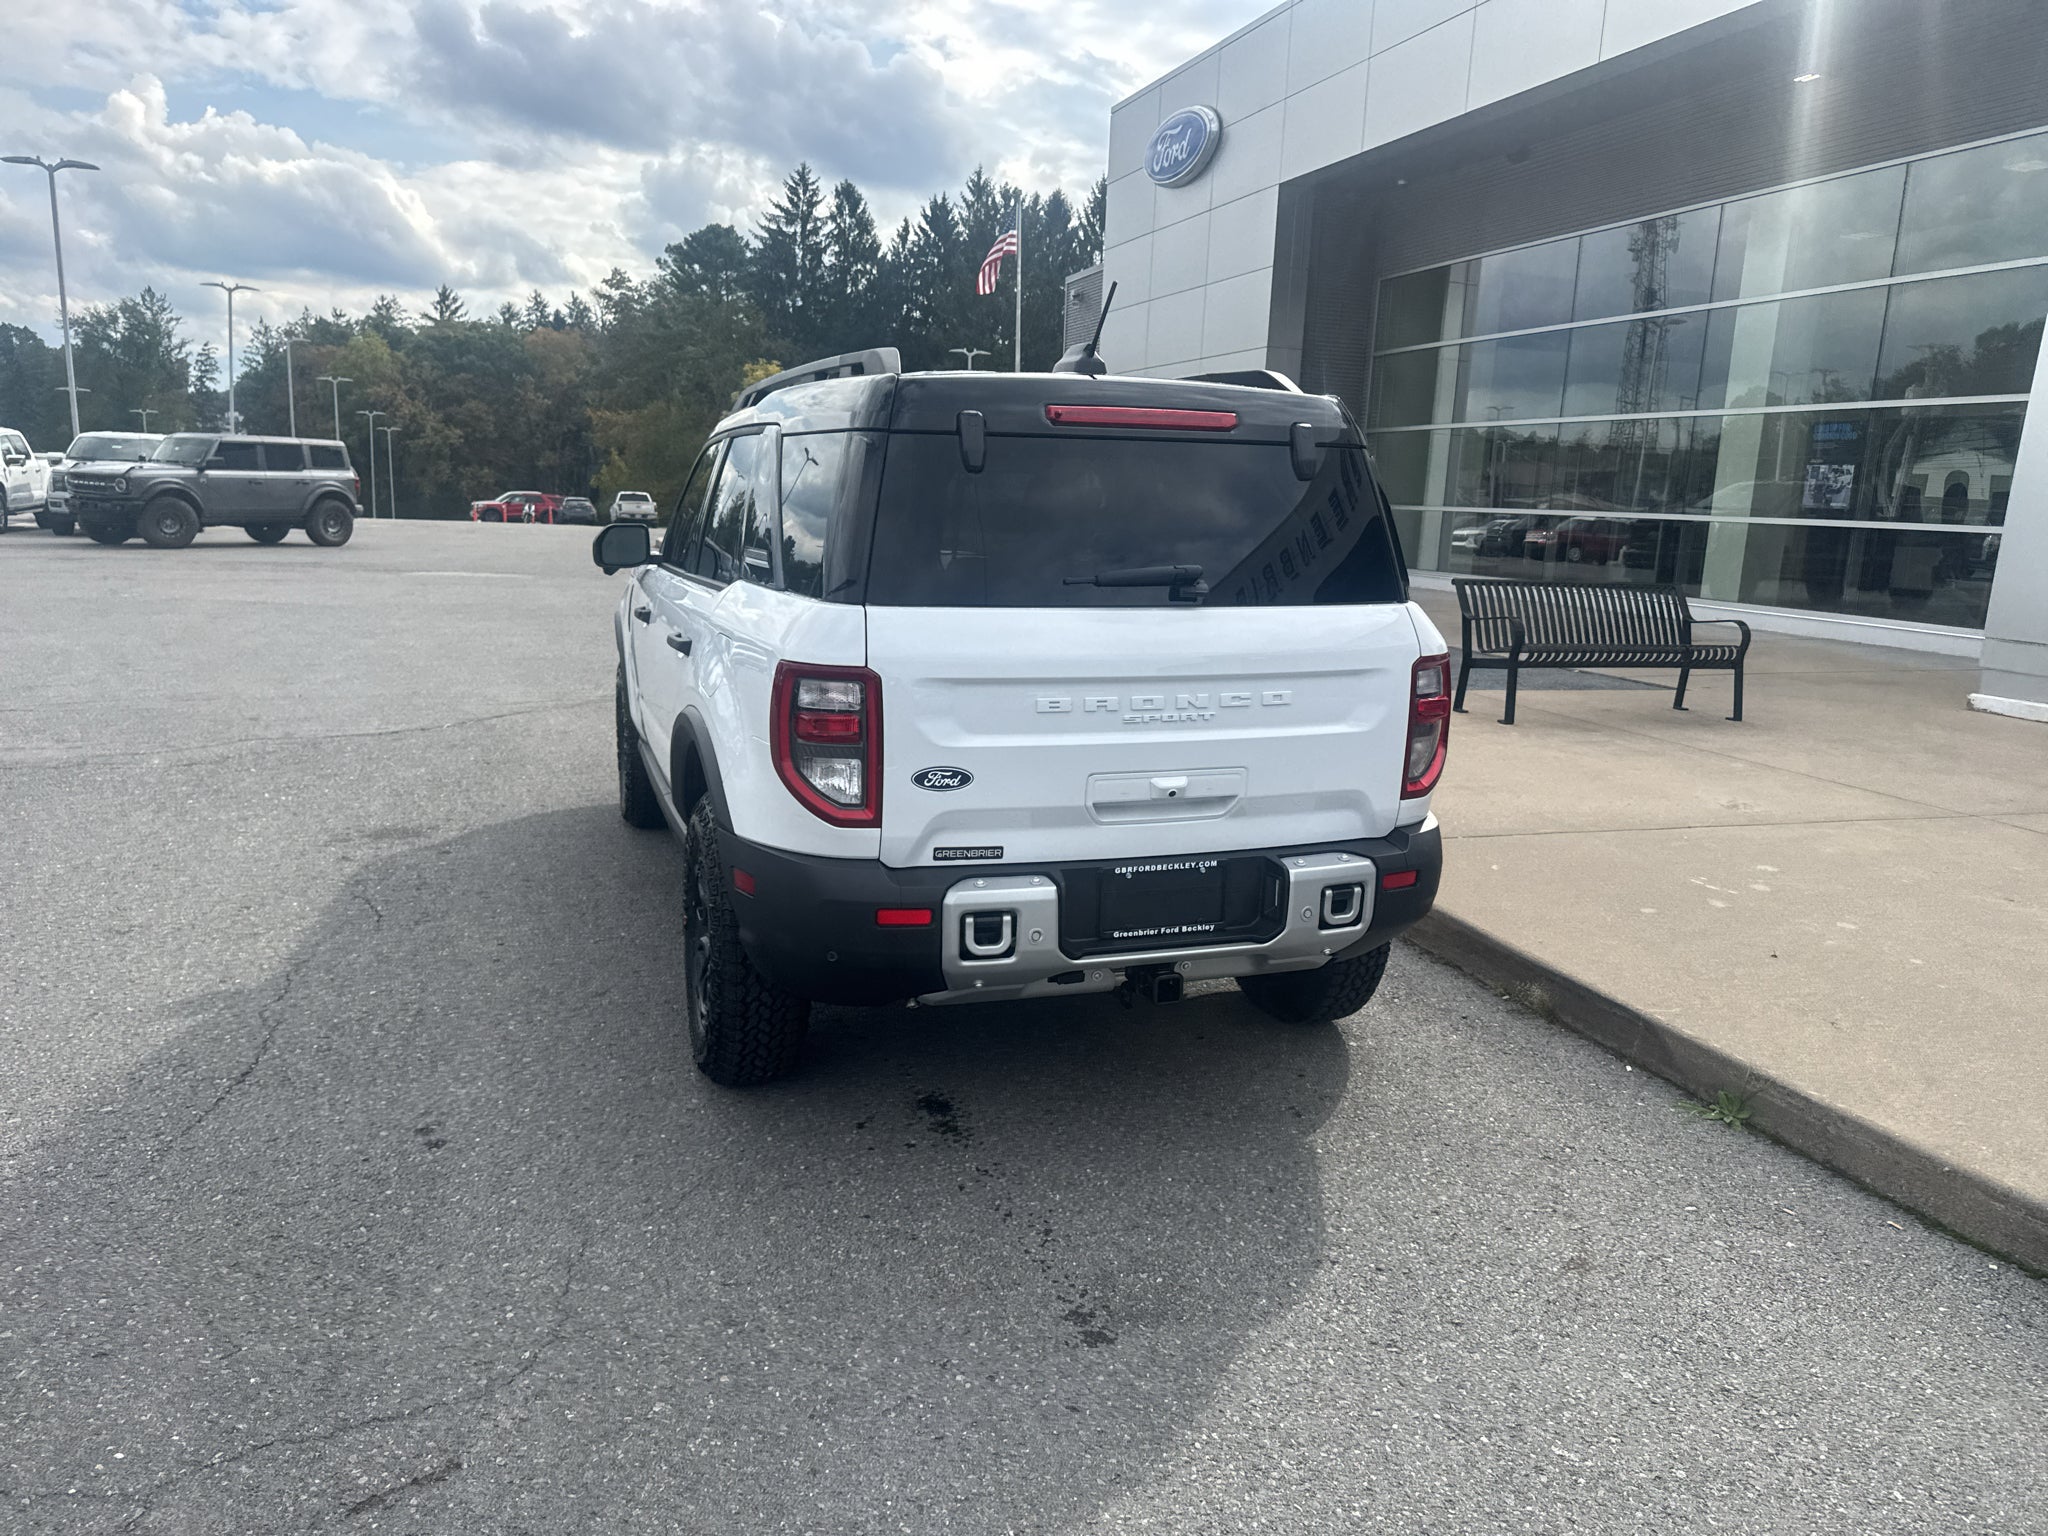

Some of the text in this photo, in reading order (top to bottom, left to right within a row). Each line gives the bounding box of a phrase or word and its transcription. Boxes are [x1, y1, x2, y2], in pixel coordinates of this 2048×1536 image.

[1153, 124, 1193, 172] Ford
[1036, 690, 1293, 713] BRONCO
[1122, 711, 1216, 724] SPORT
[923, 770, 962, 787] Ford
[934, 848, 1003, 859] GREENBRIER
[1114, 860, 1218, 874] GBRFORDBECKLEY.COM
[1113, 923, 1216, 938] Greenbrier Ford Beckley
